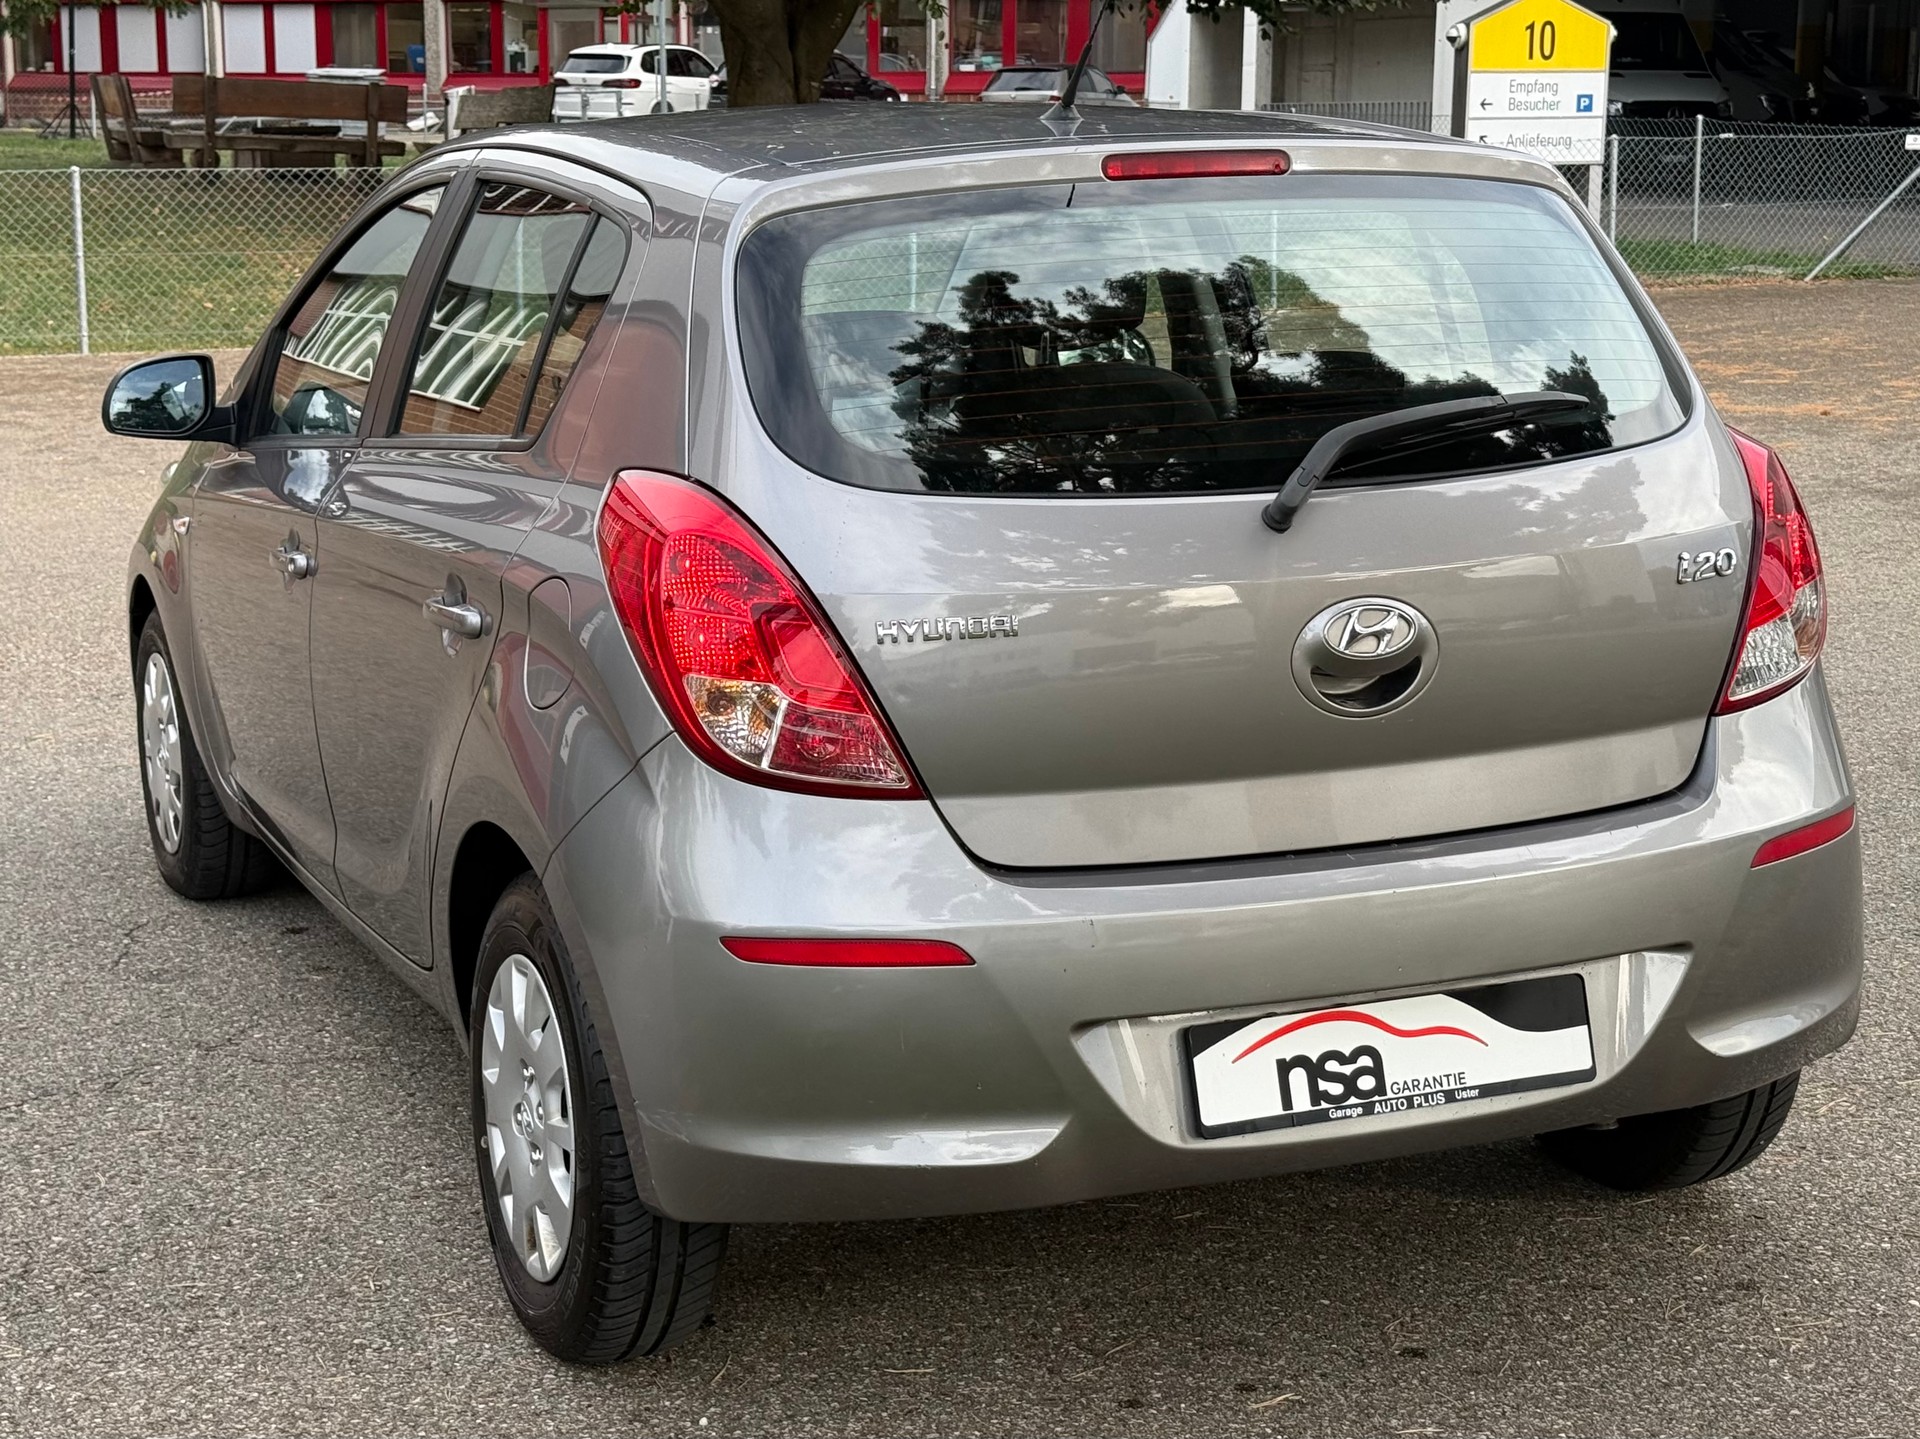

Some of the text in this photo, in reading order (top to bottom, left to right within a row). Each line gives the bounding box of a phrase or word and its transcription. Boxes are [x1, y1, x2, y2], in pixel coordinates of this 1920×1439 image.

[1525, 20, 1556, 61] 10
[1509, 79, 1559, 96] Empfang
[1508, 97, 1561, 112] Besucher
[1579, 97, 1590, 110] P
[1506, 133, 1572, 149] Anlieferung
[1676, 547, 1737, 585] i20
[875, 614, 1019, 645] HYUNDAI
[1276, 1044, 1467, 1111] nsa GARANTIE
[1328, 1087, 1480, 1119] Garage AUTO PLUS Uster
